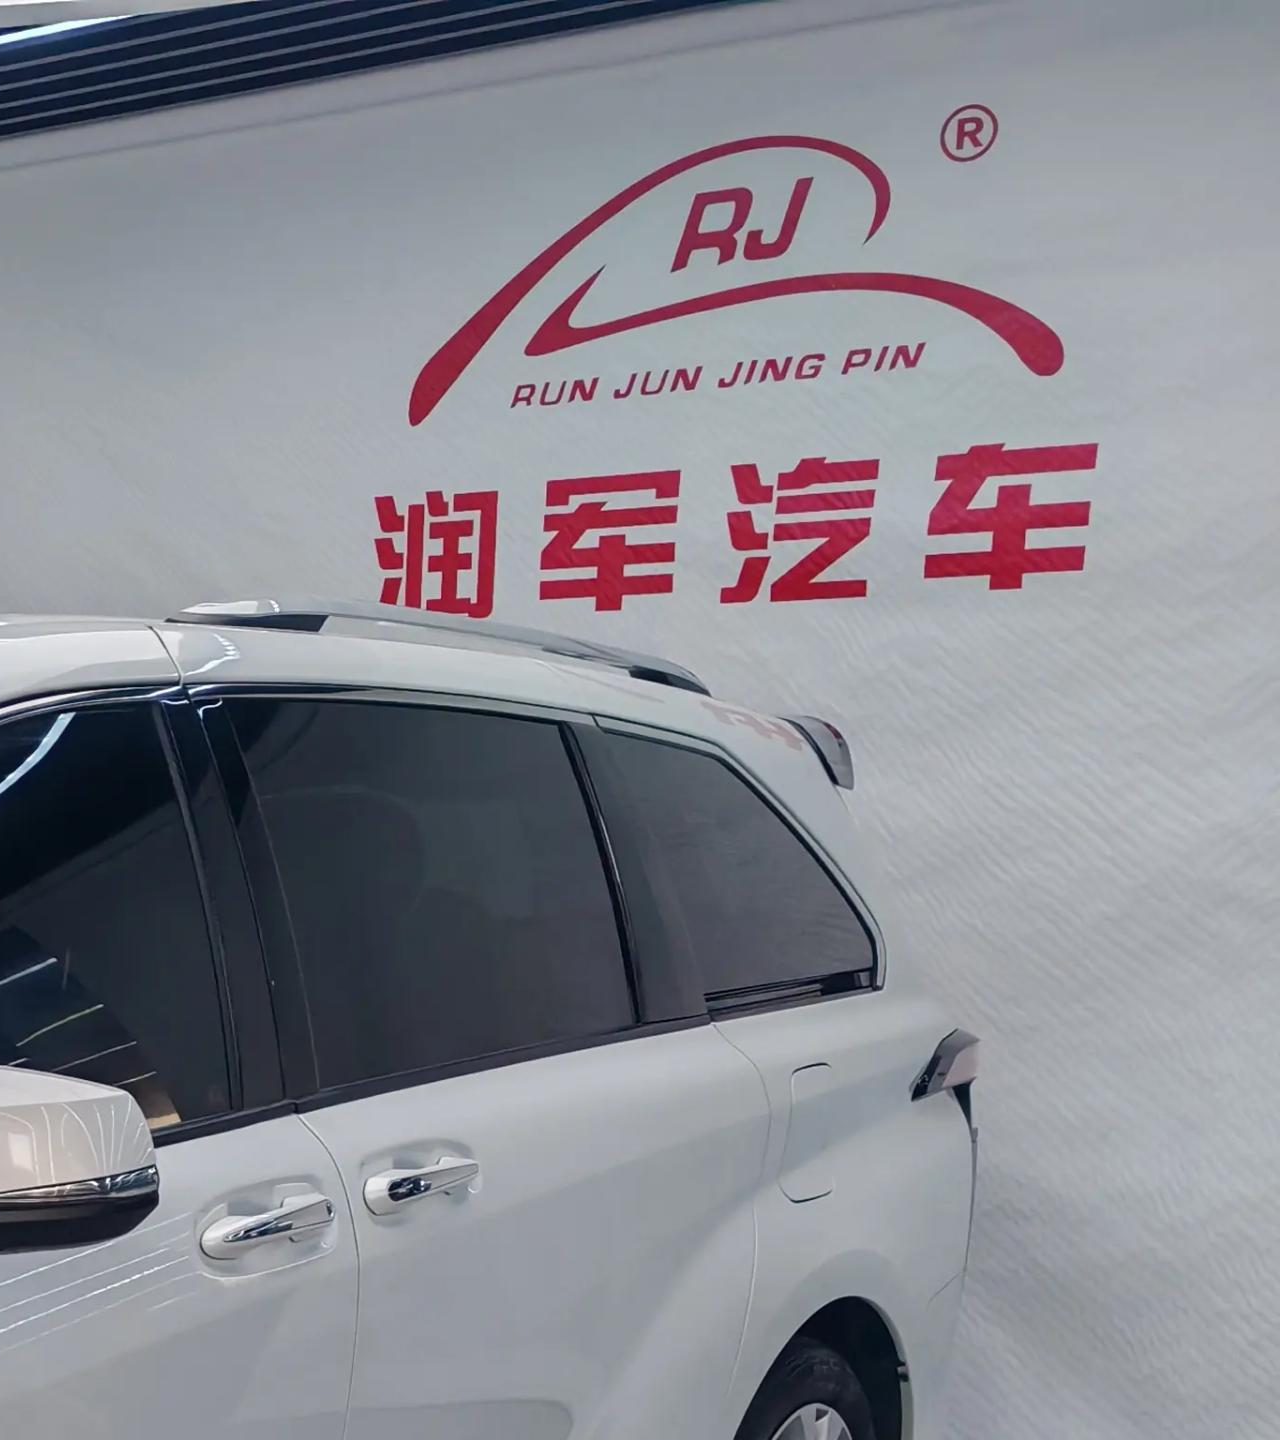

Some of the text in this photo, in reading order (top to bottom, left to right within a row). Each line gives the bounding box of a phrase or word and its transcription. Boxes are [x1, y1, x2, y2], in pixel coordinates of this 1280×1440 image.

[671, 177, 814, 273] RJ
[510, 342, 926, 409] RUN JUN JING PIN
[373, 442, 1099, 619] 润军汽车
